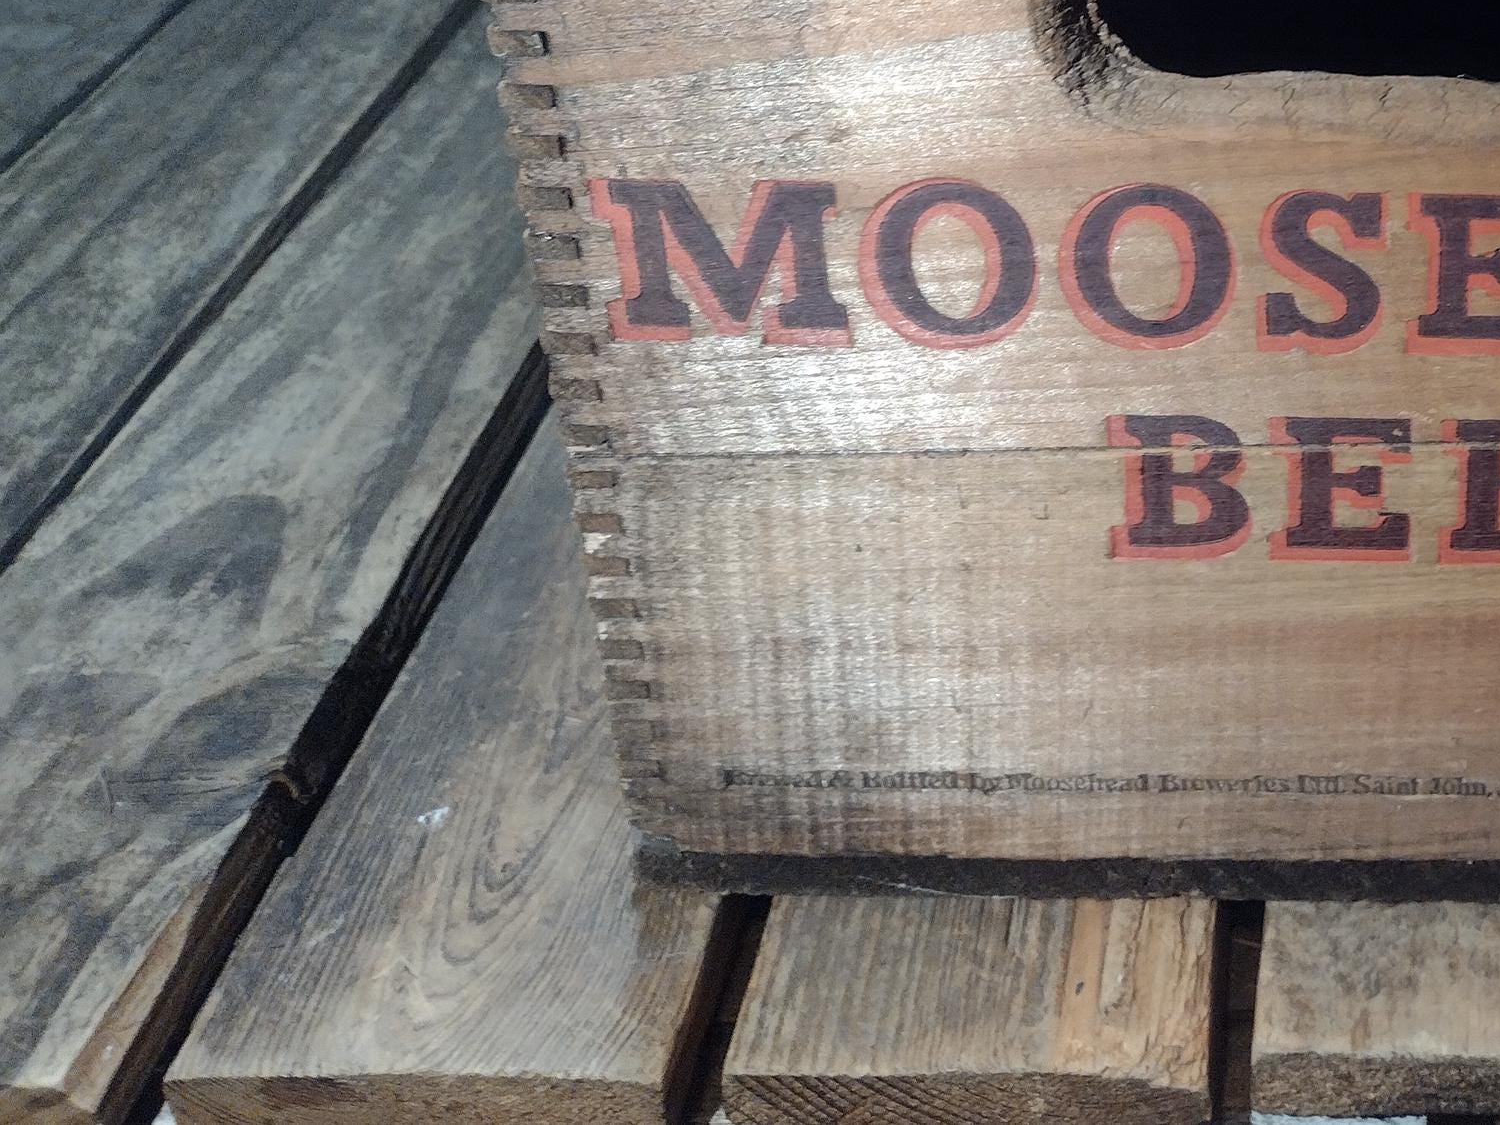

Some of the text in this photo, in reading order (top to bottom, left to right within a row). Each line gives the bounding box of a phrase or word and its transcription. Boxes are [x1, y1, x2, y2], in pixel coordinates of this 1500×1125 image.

[968, 770, 998, 795] by
[1004, 771, 1149, 794] Moosehead
[1156, 773, 1290, 795] Breweries
[1351, 773, 1420, 796] Saint
